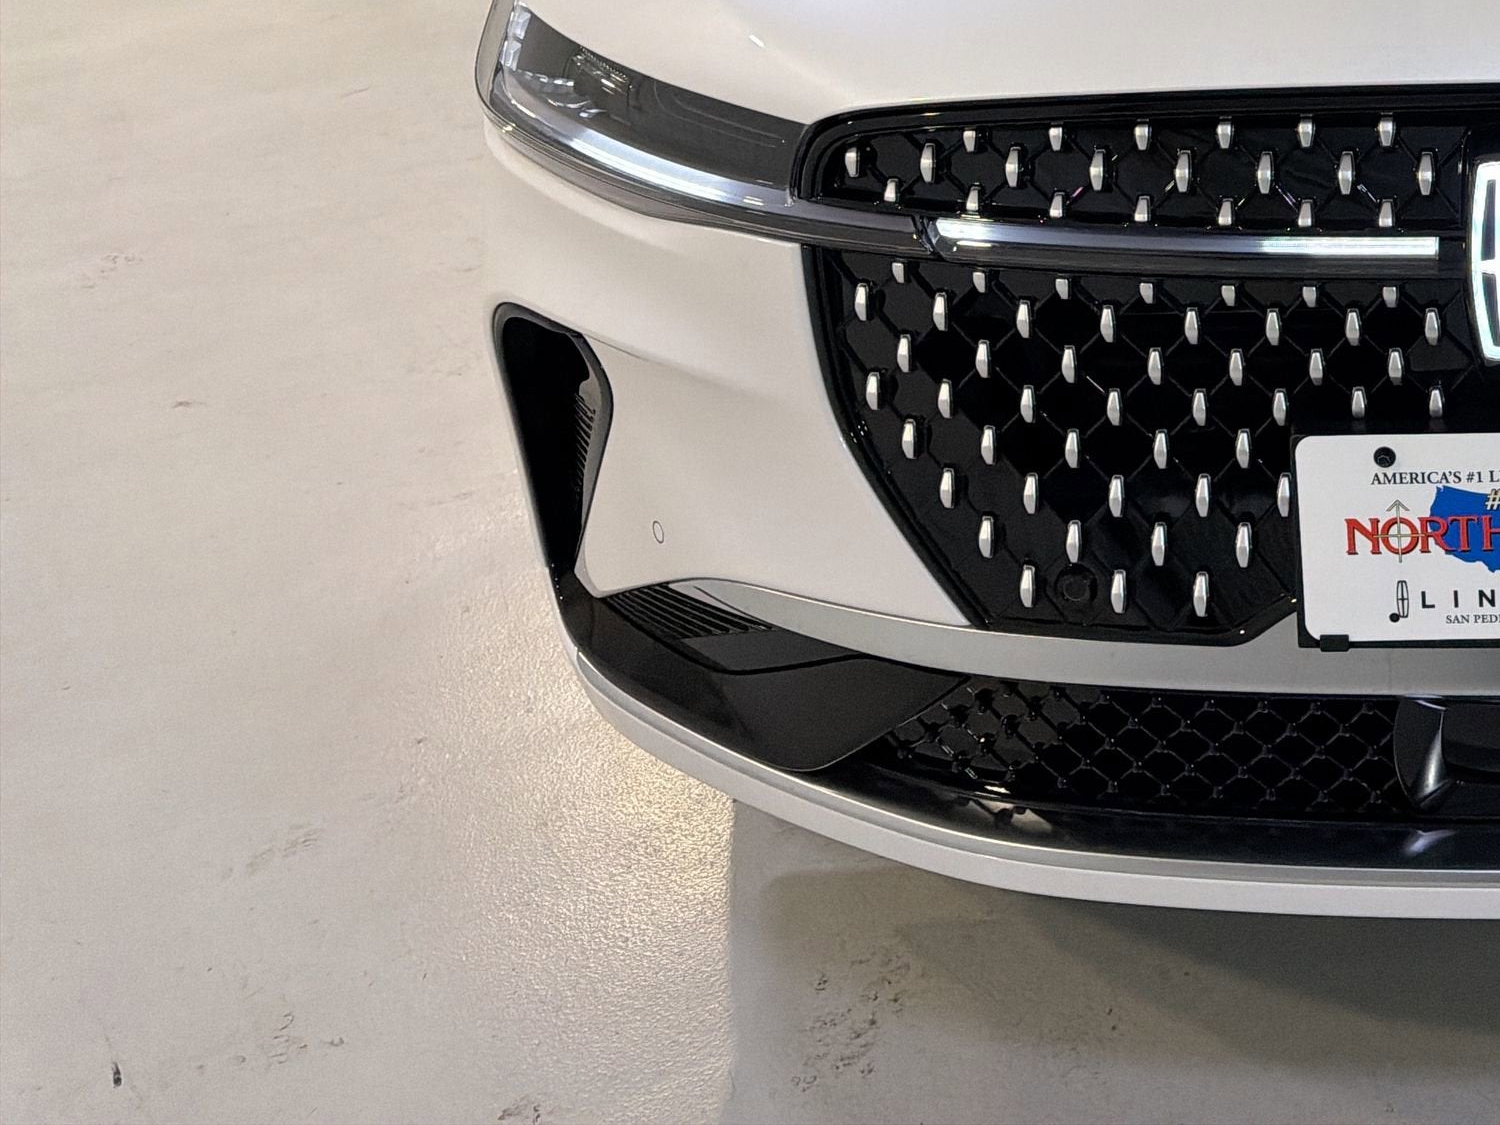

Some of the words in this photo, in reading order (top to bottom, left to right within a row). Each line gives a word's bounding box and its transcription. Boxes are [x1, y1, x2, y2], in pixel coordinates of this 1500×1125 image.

[1371, 470, 1462, 485] AMERICA'S
[1466, 470, 1484, 484] #1
[1445, 614, 1470, 625] SAN
